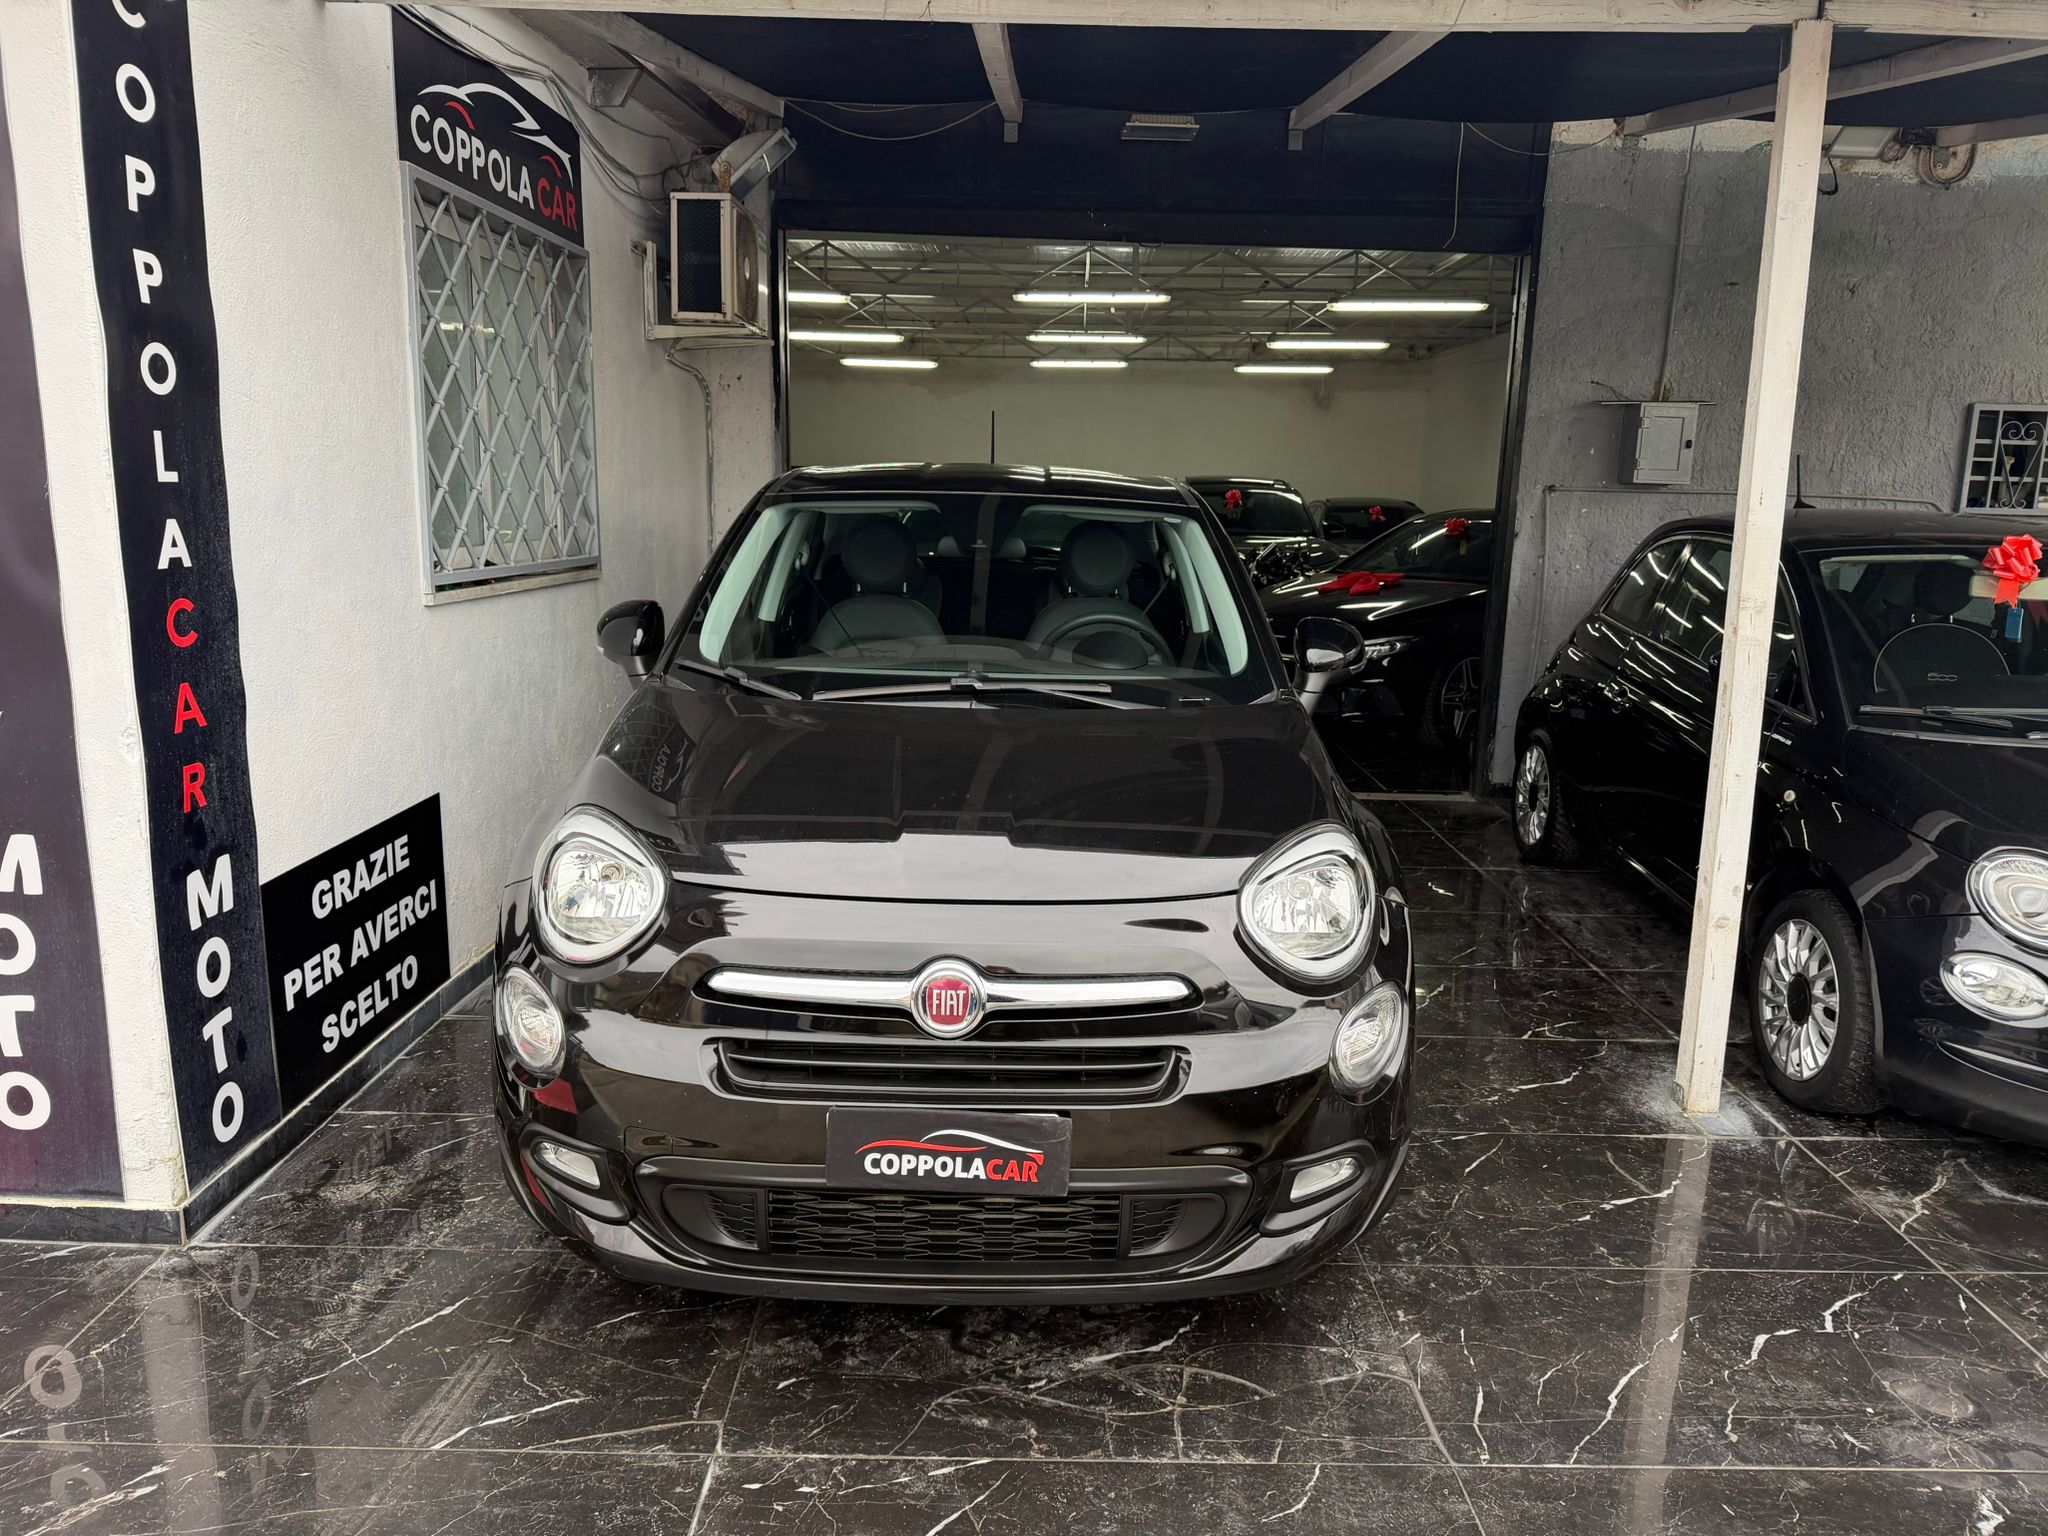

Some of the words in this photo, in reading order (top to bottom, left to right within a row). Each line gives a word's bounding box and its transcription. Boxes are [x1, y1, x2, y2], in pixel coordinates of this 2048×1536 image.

[410, 104, 535, 210] COPPOLA
[537, 177, 578, 231] CAR
[311, 834, 410, 919] GRAZIE
[186, 853, 245, 1144] MOTO
[283, 943, 344, 1012] PER
[350, 878, 437, 967] AVERCI
[321, 955, 418, 1053] SCELTO
[932, 989, 967, 1016] FIAT
